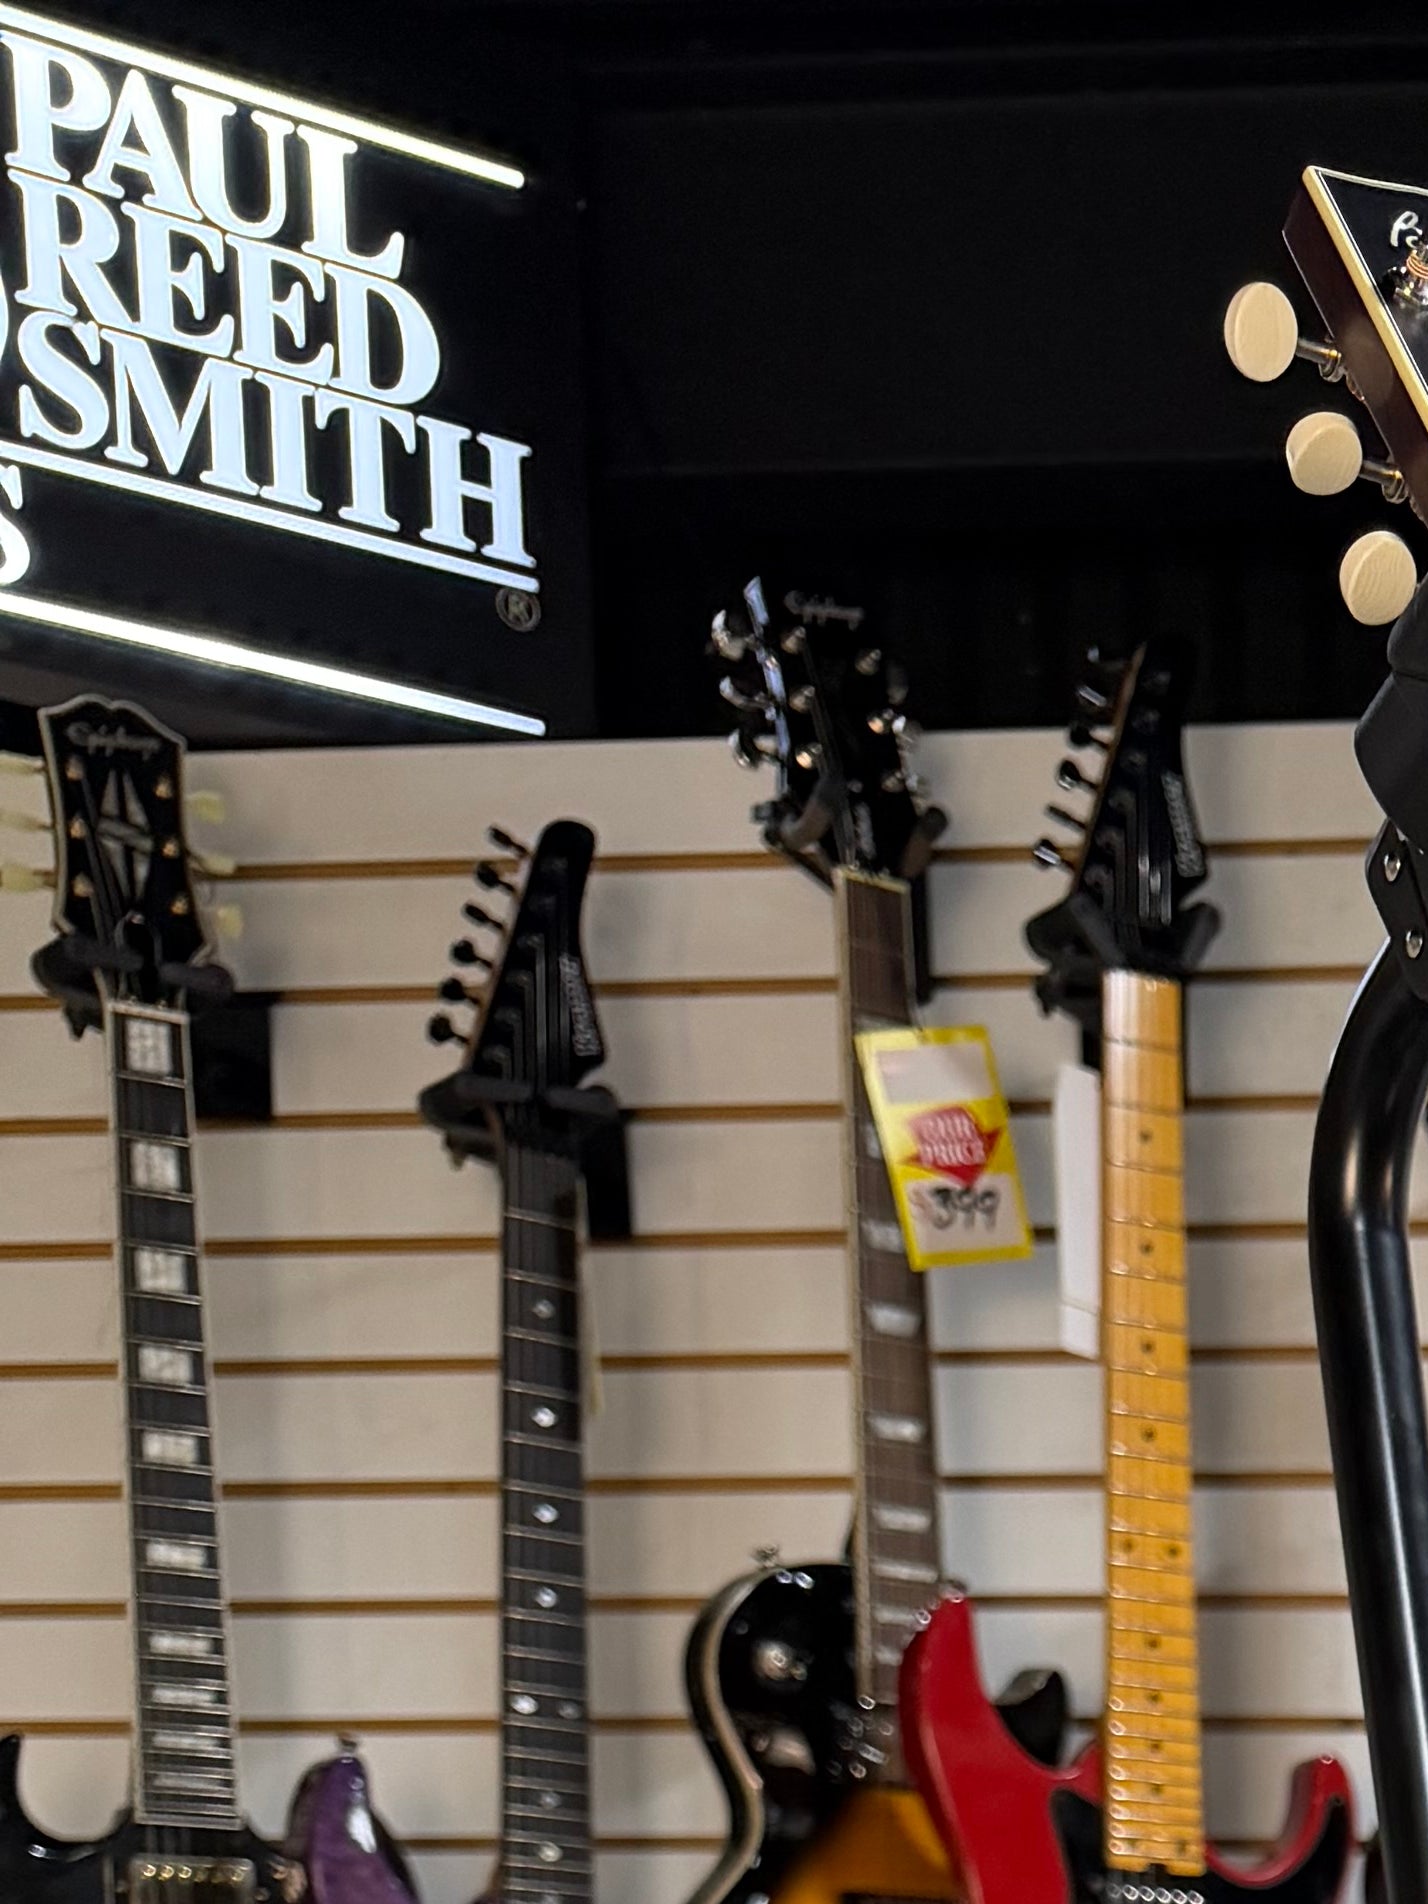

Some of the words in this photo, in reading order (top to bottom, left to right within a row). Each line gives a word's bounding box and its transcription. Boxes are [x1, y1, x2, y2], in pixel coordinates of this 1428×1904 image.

[1, 31, 405, 280] PAUL
[7, 168, 443, 407] REED
[18, 311, 539, 569] SMITH
